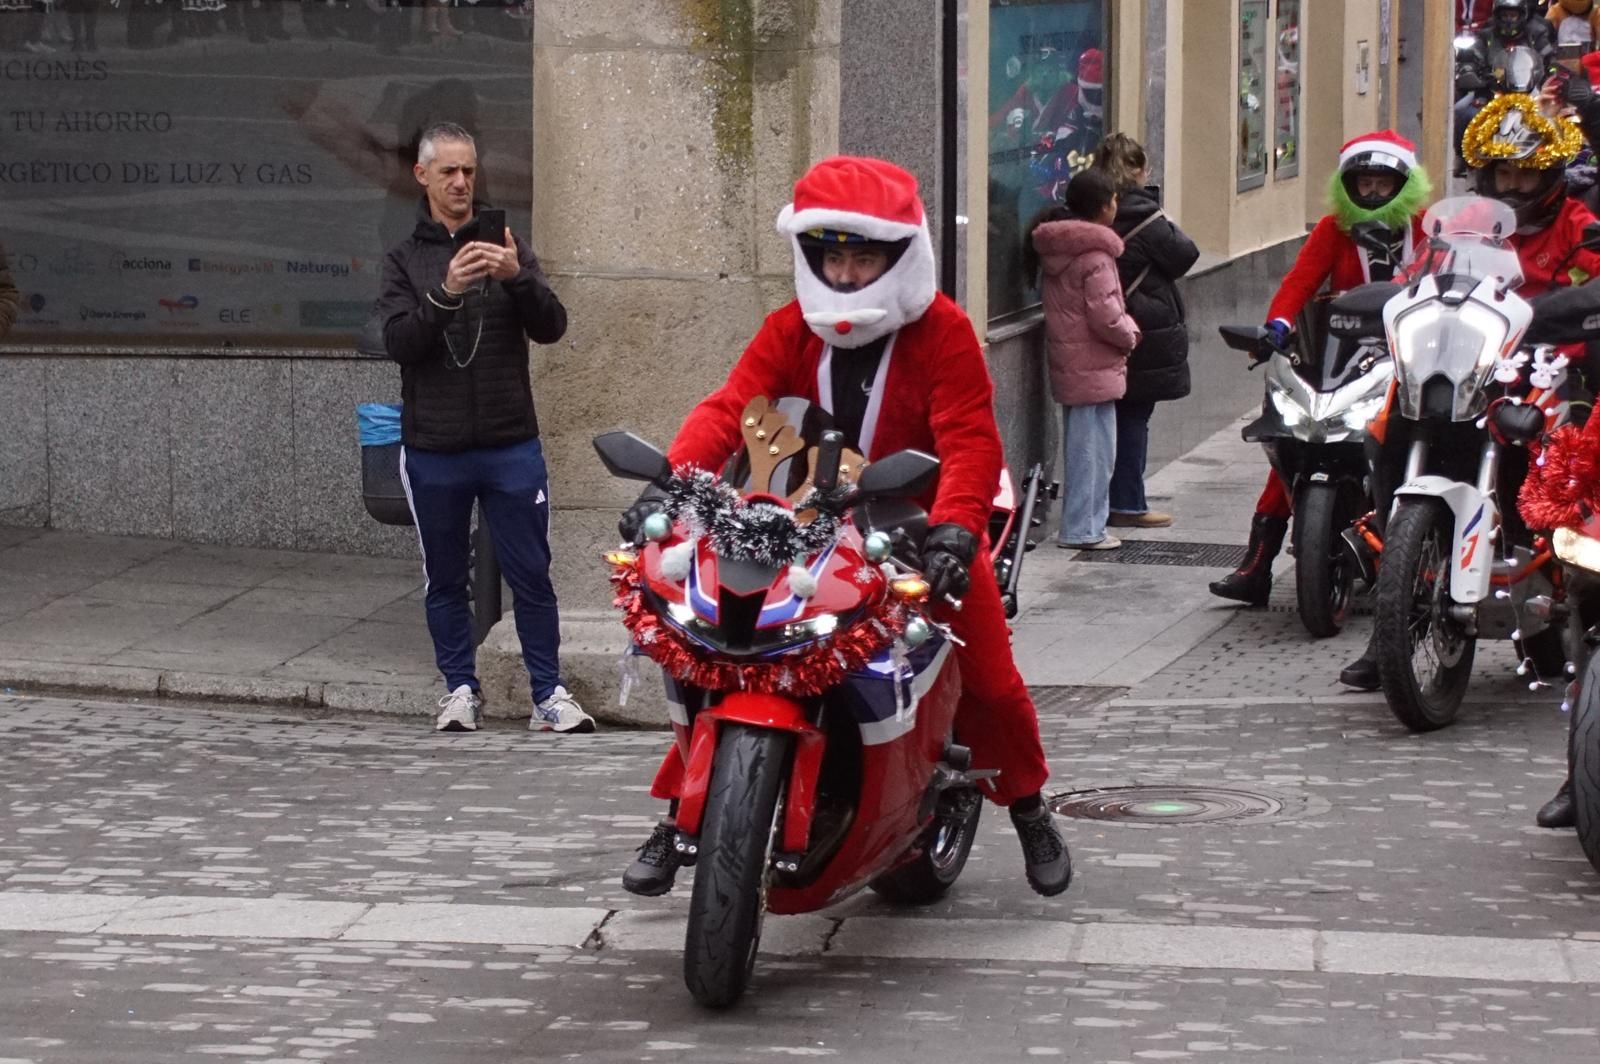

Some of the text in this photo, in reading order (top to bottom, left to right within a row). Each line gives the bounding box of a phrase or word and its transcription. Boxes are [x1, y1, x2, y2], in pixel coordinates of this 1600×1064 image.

[9, 111, 173, 132] TU AHORRO
[122, 163, 159, 184] DE
[170, 163, 222, 184] LUZ
[230, 163, 248, 184] Y
[256, 163, 313, 184] GAS
[122, 257, 172, 270] acciona
[286, 261, 349, 277] Naturgy
[219, 308, 252, 324] ELE
[1329, 314, 1362, 330] GIVI
